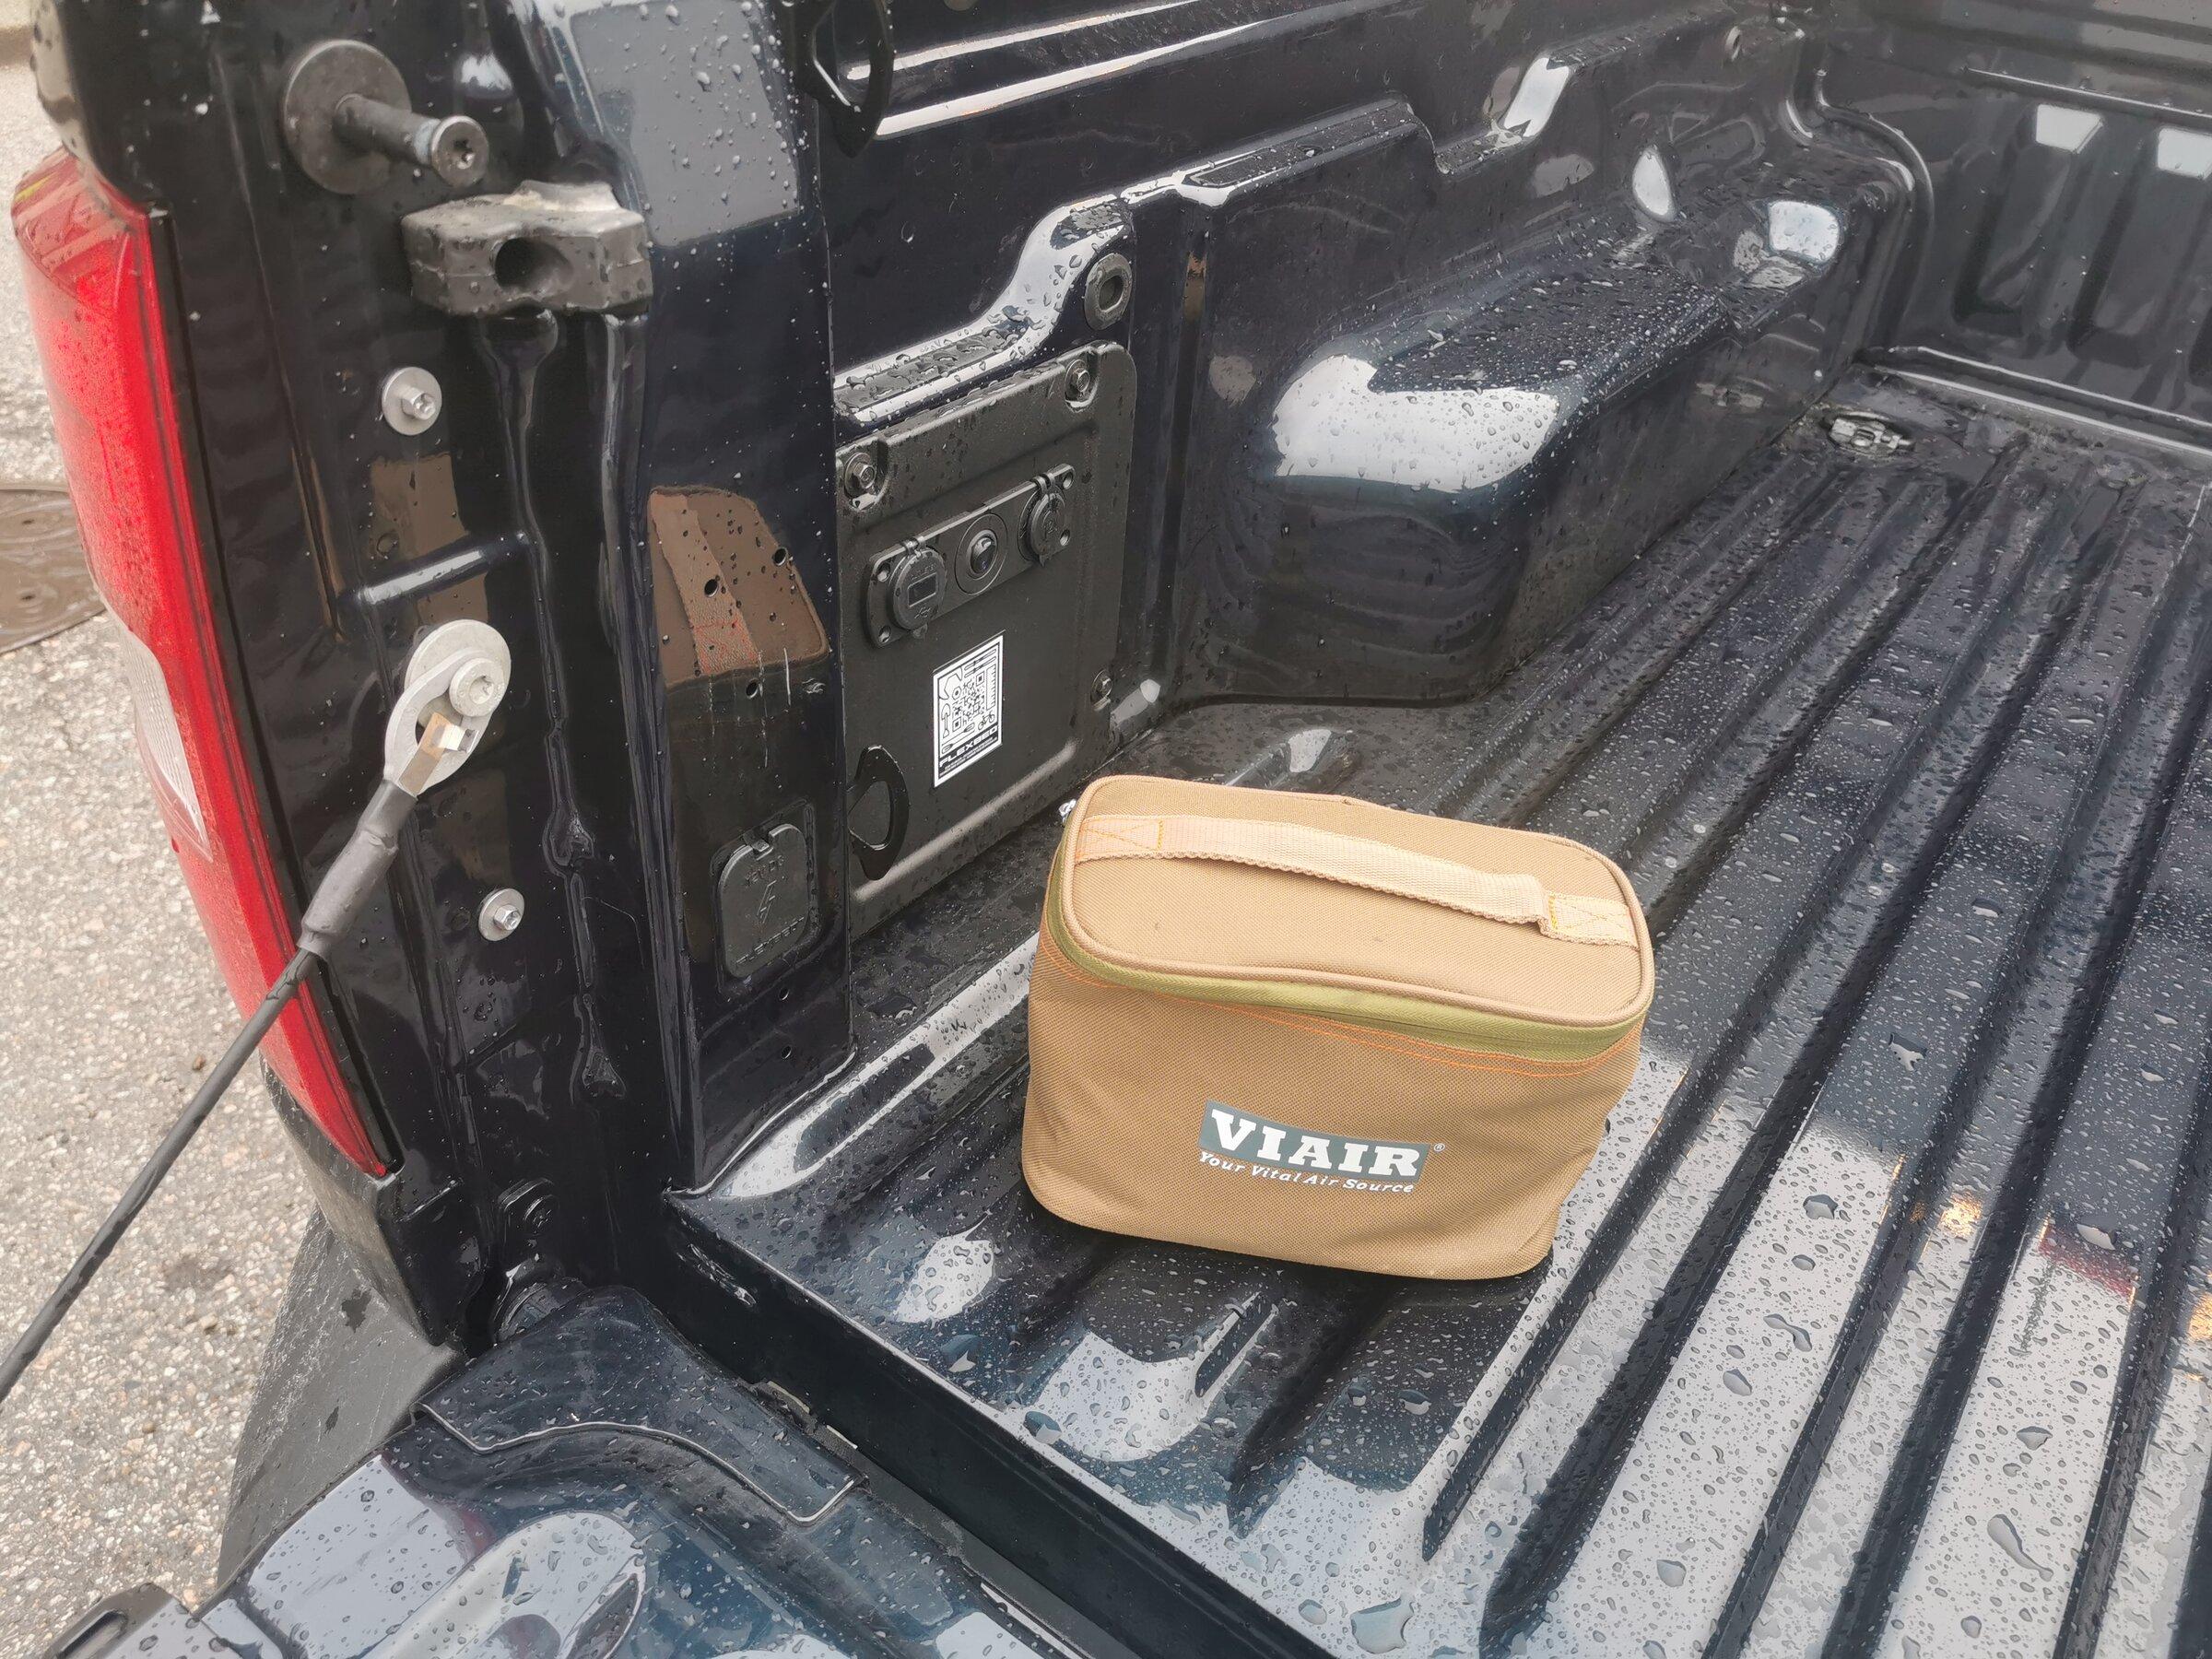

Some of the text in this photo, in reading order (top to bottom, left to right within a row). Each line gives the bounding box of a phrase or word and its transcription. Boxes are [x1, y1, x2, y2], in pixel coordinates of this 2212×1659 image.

[1211, 1108, 1420, 1177] VIAIR
[1199, 1151, 1415, 1194] Your Vital Air Source
